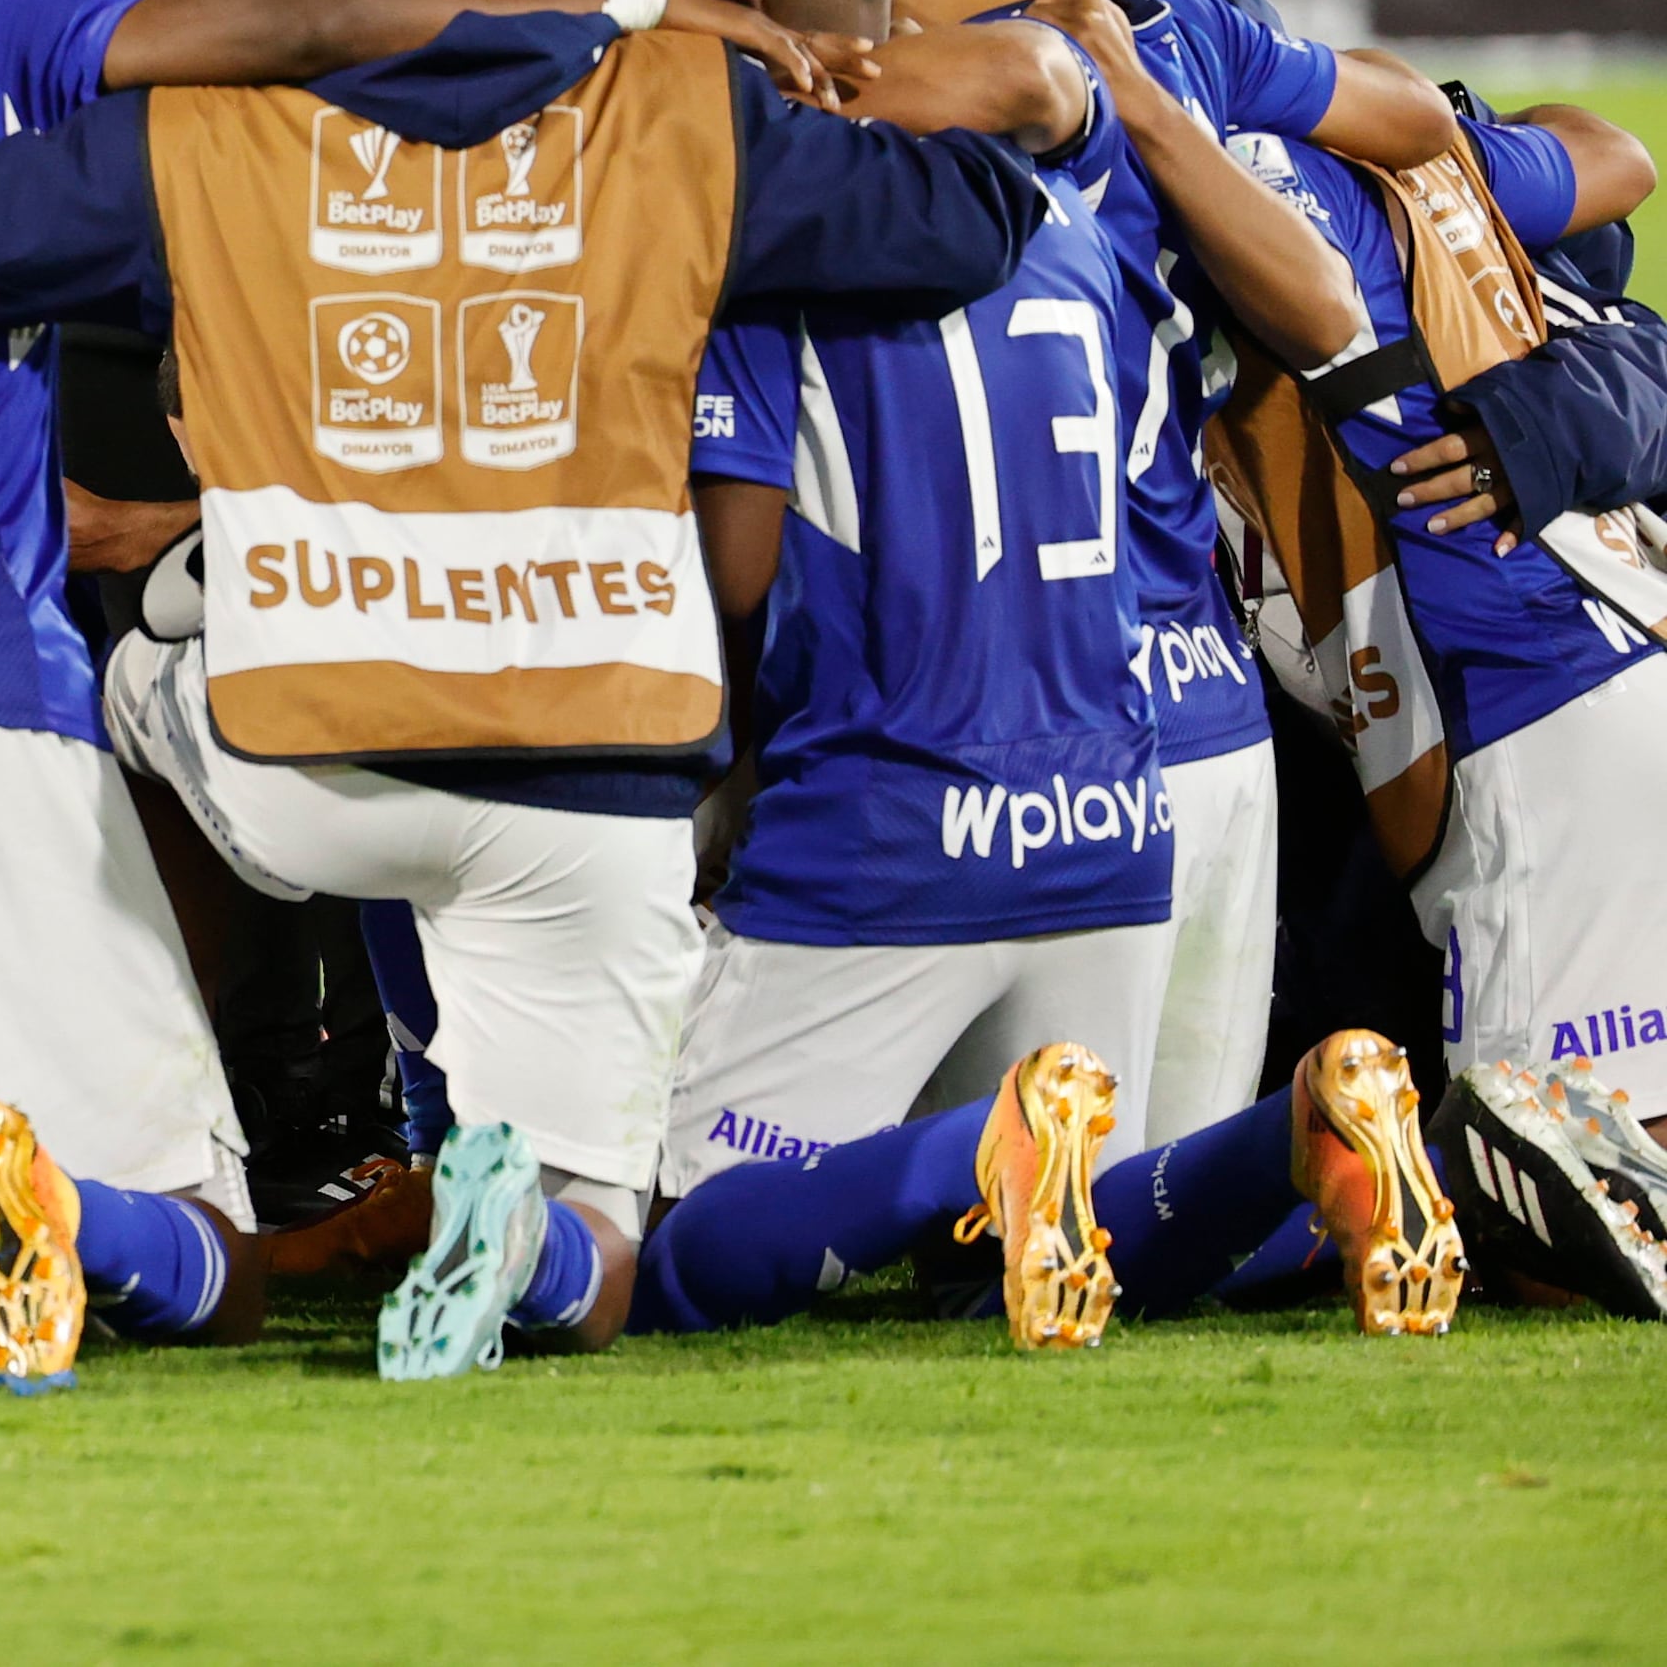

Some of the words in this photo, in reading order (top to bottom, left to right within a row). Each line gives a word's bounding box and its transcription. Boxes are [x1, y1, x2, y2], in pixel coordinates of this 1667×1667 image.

[327, 200, 424, 233] BetPlay
[475, 199, 566, 228] BetPlay
[338, 244, 412, 258] DIMAYOR
[488, 241, 555, 257] DIMAYOR
[329, 395, 424, 427] BetPlay
[481, 399, 564, 426] BetPlay
[341, 442, 414, 457] DIMAYOR
[489, 436, 559, 456] DIMAYOR
[939, 298, 1117, 582] 13
[245, 539, 676, 624] SUPLENTES
[1550, 1005, 1667, 1062] Allia
[708, 1106, 832, 1161] Allian
